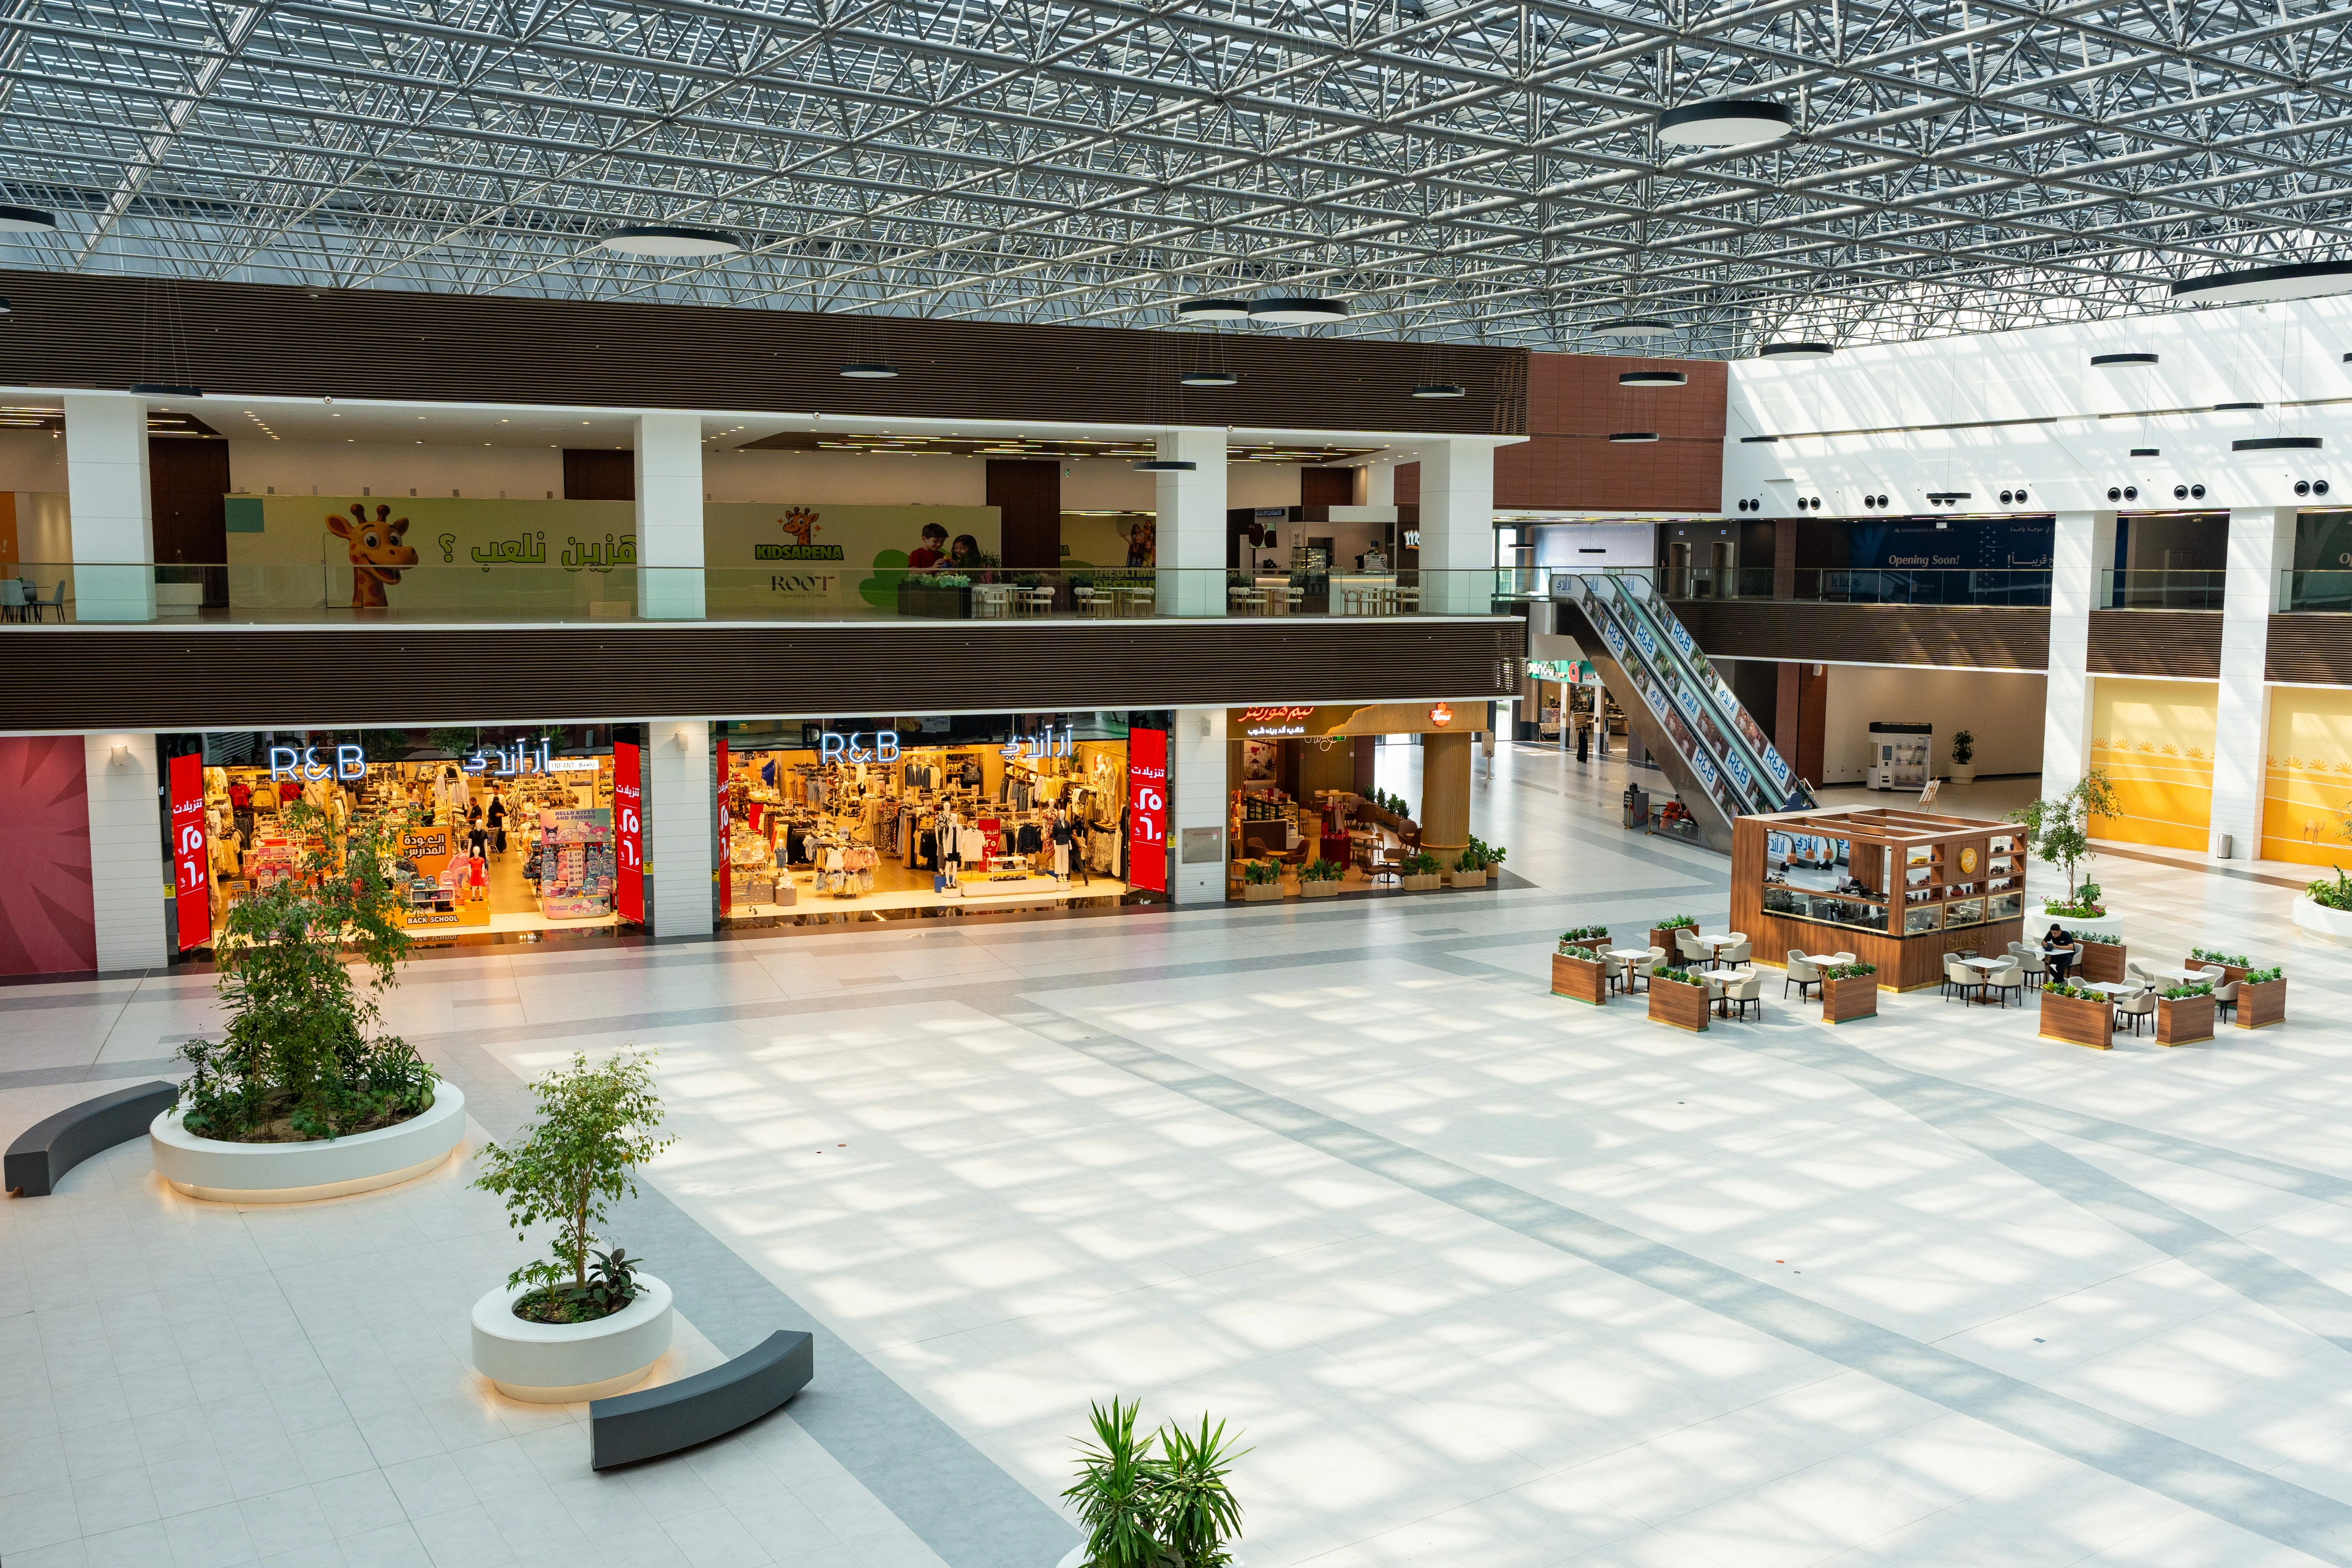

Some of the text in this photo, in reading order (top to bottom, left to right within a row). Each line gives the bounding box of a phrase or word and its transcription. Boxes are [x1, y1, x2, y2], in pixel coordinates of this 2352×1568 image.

[472, 531, 546, 572] نلعب
[755, 544, 844, 560] KIDSARENA
[1545, 556, 1581, 565] Opening Soon!
[1888, 555, 1960, 567] Opening Soon!
[1092, 566, 1115, 578] THE
[771, 576, 835, 592] ROOT
[1607, 622, 1624, 652] R&B
[1637, 624, 1654, 654] R&B
[1673, 622, 1691, 652] R&B
[1432, 709, 1451, 721] Tims
[821, 729, 901, 765] R&B
[998, 725, 1053, 760] آندي
[1055, 724, 1073, 758] آر
[269, 744, 367, 782] R&B
[461, 737, 551, 778] آر آندي
[1695, 748, 1715, 783] R&B
[1766, 747, 1787, 780] R&B
[1131, 766, 1165, 778] تنزيلات
[1728, 751, 1748, 785] R&B
[616, 785, 640, 798] تنزيلات
[173, 798, 203, 814] تنزيلات
[404, 834, 445, 848] العودة
[1768, 835, 1779, 853] آند
[405, 845, 446, 858] المدارس
[1946, 935, 1972, 949] Coffee
